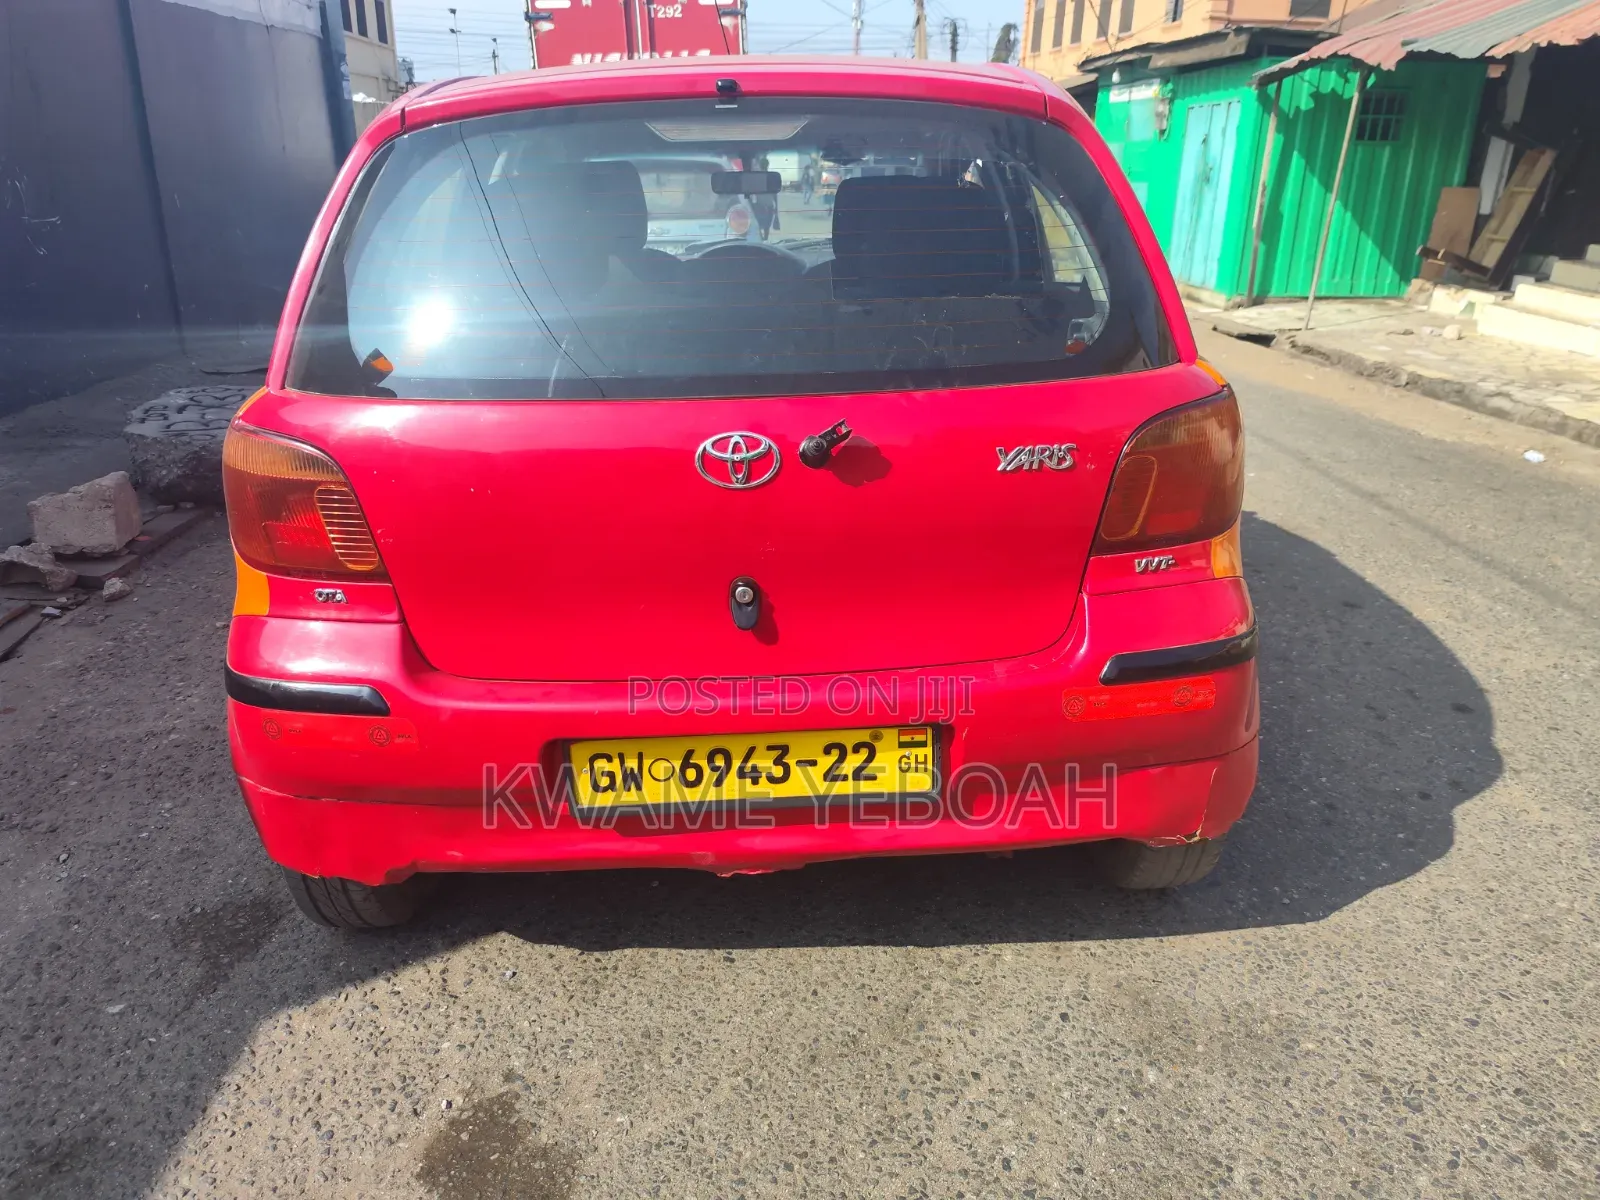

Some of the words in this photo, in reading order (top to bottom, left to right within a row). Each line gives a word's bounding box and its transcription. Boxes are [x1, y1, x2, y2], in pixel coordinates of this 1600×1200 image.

[996, 443, 1076, 471] YARIS
[588, 751, 644, 793] GW
[678, 741, 877, 788] 6943-22
[898, 753, 928, 773] GH
